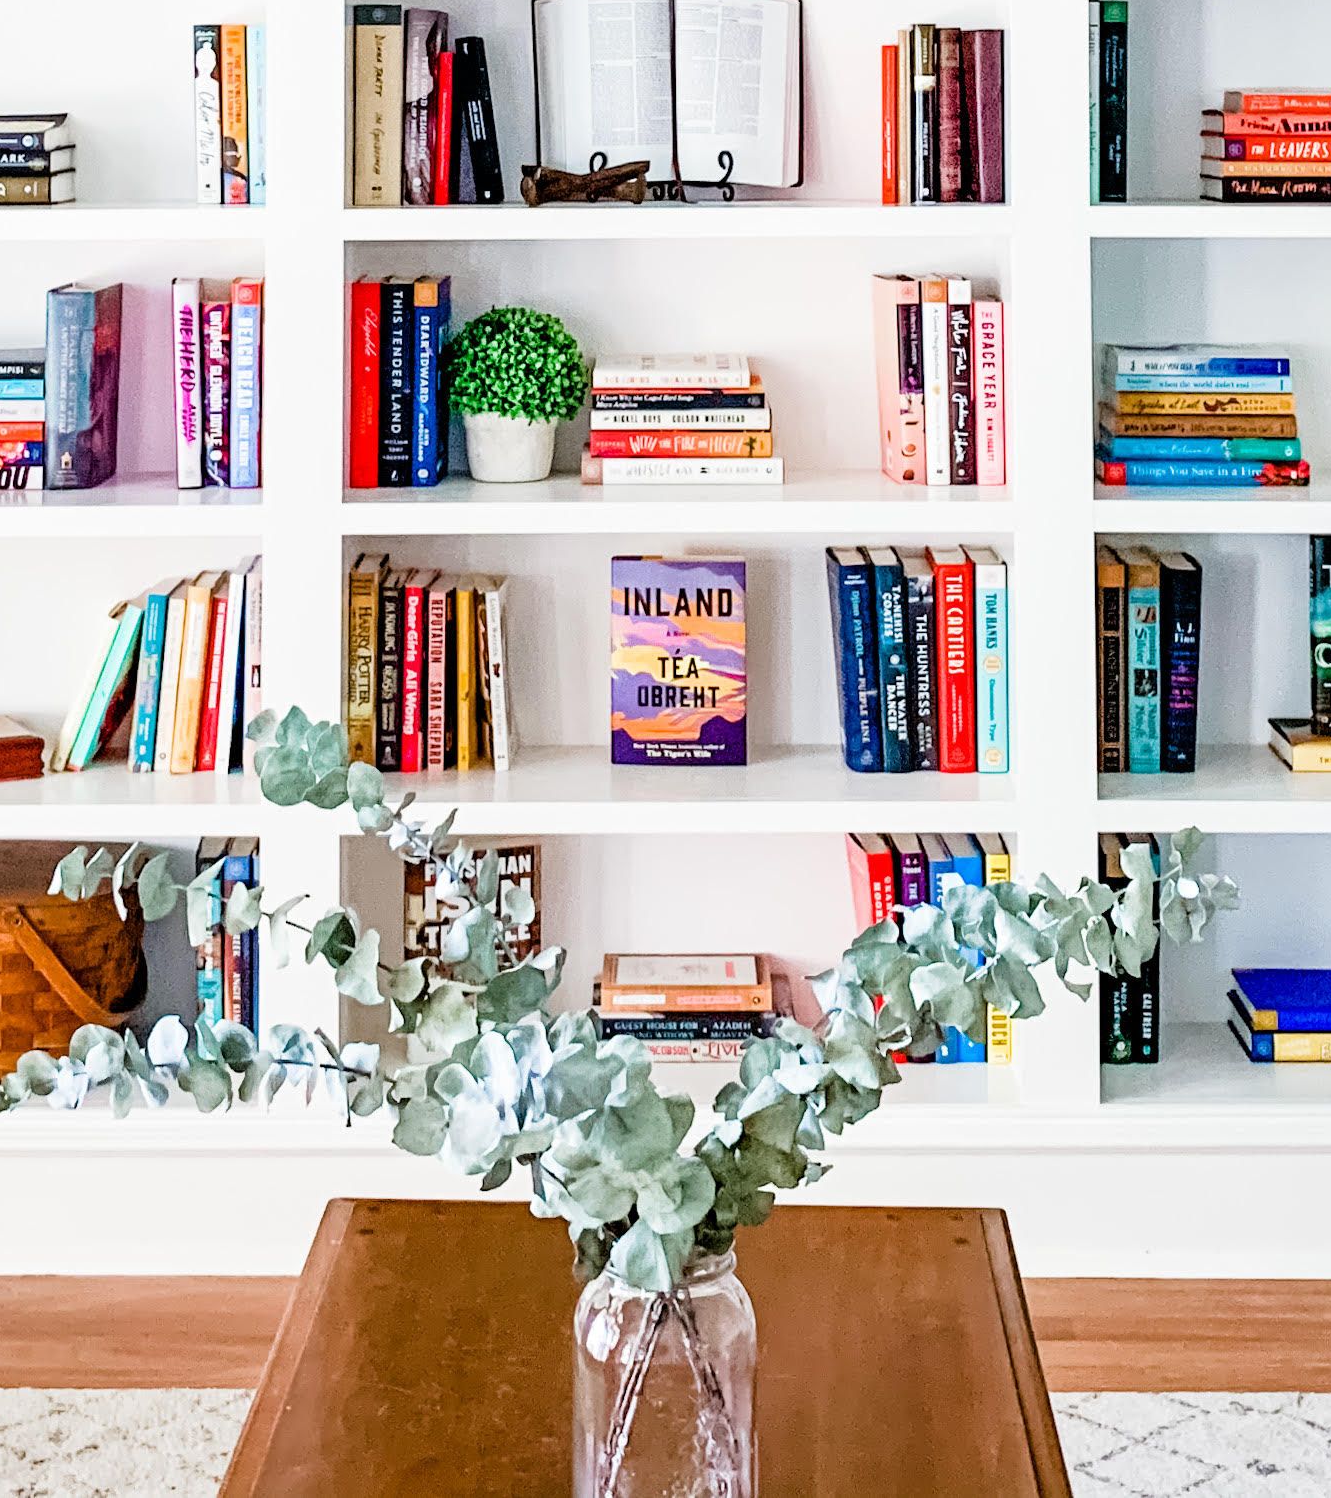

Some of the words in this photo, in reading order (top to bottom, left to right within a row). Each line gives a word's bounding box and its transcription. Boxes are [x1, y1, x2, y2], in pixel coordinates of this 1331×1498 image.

[1270, 142, 1331, 158] LEAVERS
[179, 308, 194, 338] THE
[392, 291, 403, 322] THIS
[208, 311, 222, 358] UNTAMED
[237, 317, 253, 369] BEACH
[419, 316, 430, 348] DEAR
[982, 322, 996, 369] GRACE
[179, 341, 195, 393] HERD
[391, 331, 402, 387] TENDER
[419, 351, 429, 403] EDWARD
[208, 365, 222, 410] GLENNON
[237, 372, 254, 409] READ
[982, 375, 996, 409] YEAR
[207, 413, 222, 446] DOYLE
[391, 394, 402, 434] LAND
[624, 587, 734, 617] INLAND
[946, 575, 963, 602] THE
[985, 593, 997, 616] TOM
[358, 606, 373, 652] HARRY
[407, 596, 419, 631] Dear
[430, 599, 443, 663] REPUTATION
[916, 615, 928, 640] THE
[406, 631, 417, 662] Girls
[947, 607, 965, 674] CARTIERS
[985, 618, 997, 648] HANKS
[358, 654, 373, 706] POTTER
[657, 648, 699, 679] TÉA
[917, 644, 930, 716] HUNTRESS
[403, 692, 417, 734] Wong
[430, 682, 442, 710] SARA
[637, 685, 719, 708] OBREHT
[887, 684, 897, 730] DANCER
[897, 699, 907, 740] WATER
[429, 716, 442, 765] SHEPARD
